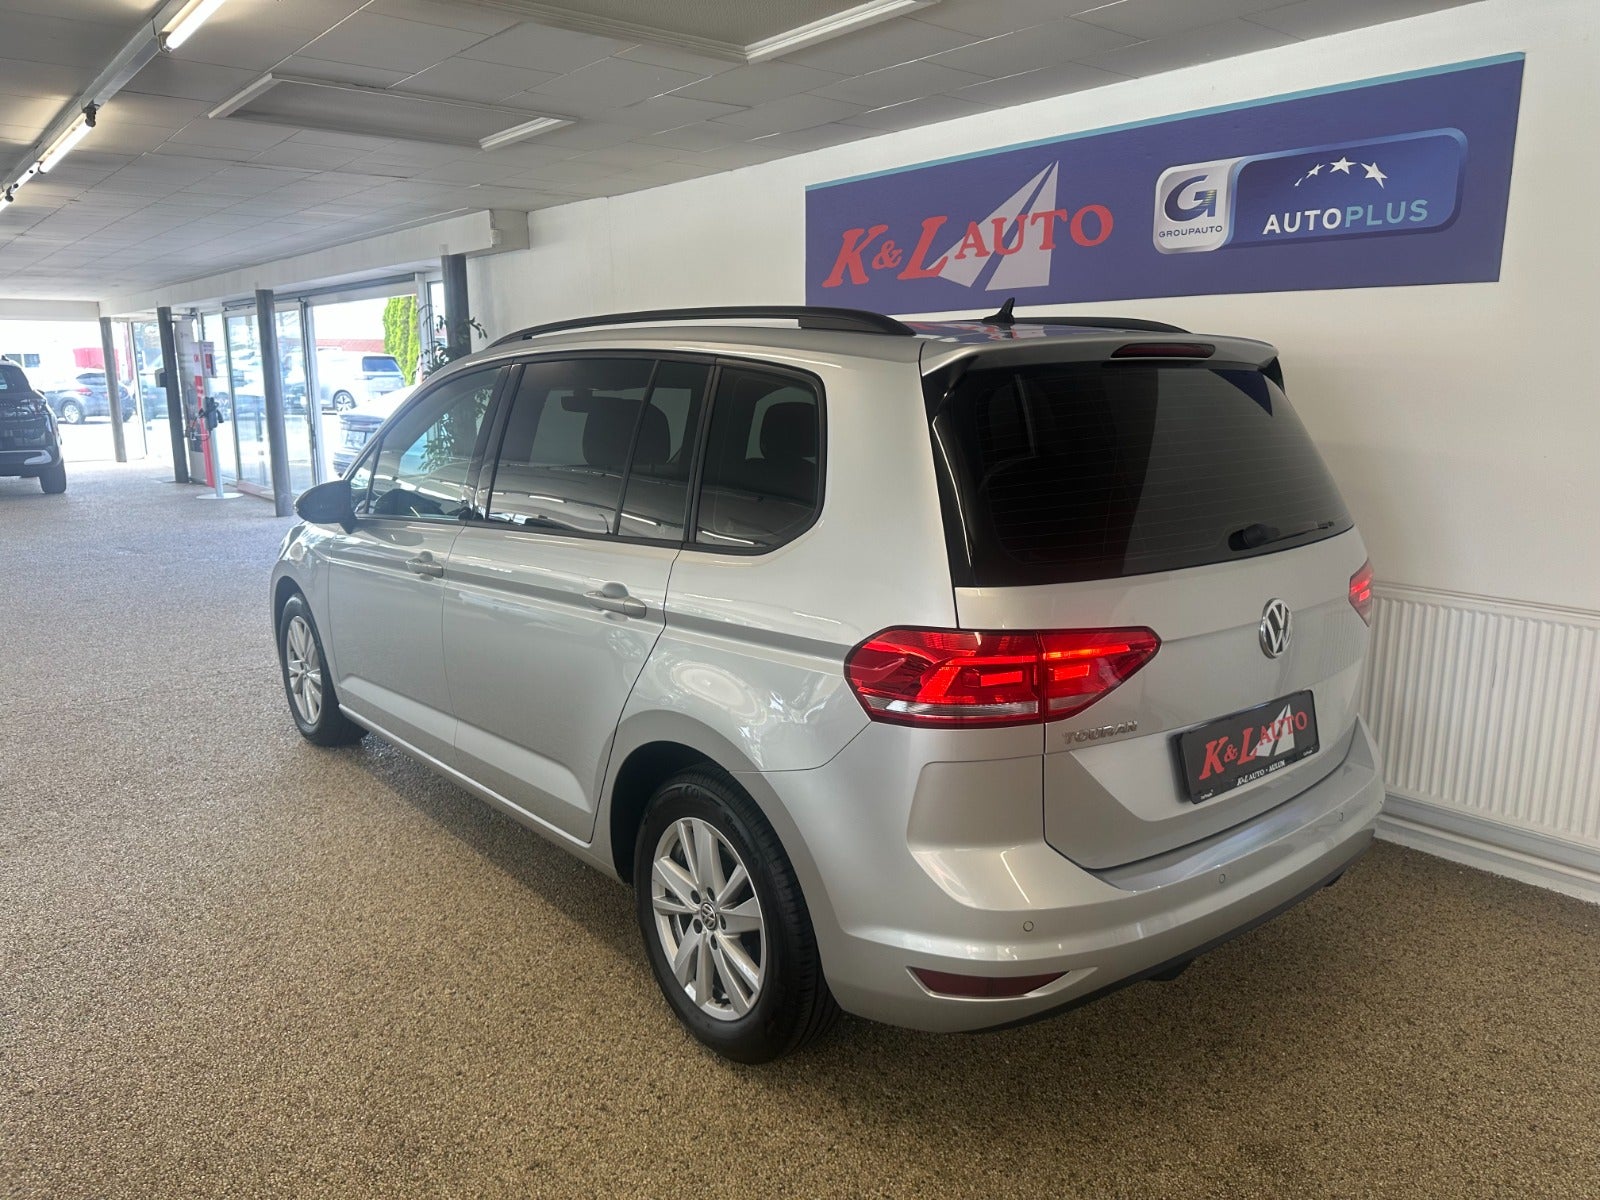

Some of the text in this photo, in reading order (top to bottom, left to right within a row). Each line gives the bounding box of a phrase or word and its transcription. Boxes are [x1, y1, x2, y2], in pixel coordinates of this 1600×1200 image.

[954, 204, 1114, 260] AUTO
[1158, 225, 1224, 239] GROUPAUTO
[1262, 199, 1429, 236] AUTOPLUS
[1063, 720, 1137, 744] TOURAN
[1258, 711, 1308, 747] AUTO
